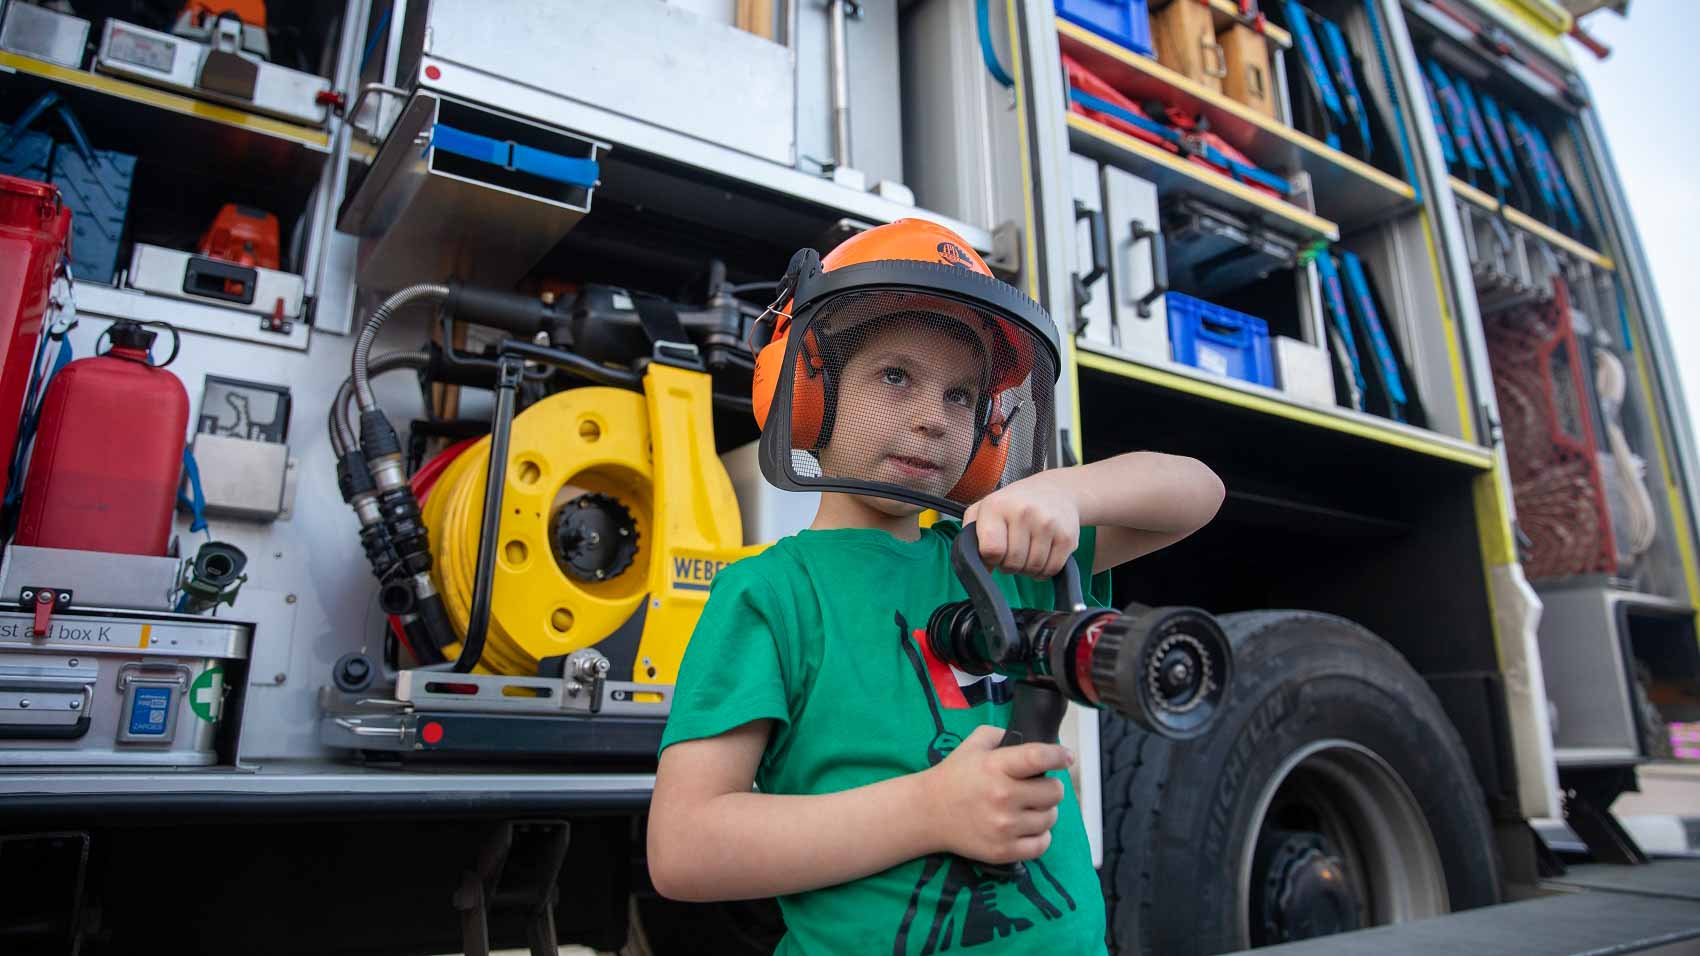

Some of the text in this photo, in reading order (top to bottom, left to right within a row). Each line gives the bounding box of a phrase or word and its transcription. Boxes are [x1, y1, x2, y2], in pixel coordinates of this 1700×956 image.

[674, 556, 731, 580] WEB
[0, 623, 18, 638] st
[59, 625, 92, 641] box
[98, 626, 111, 641] K
